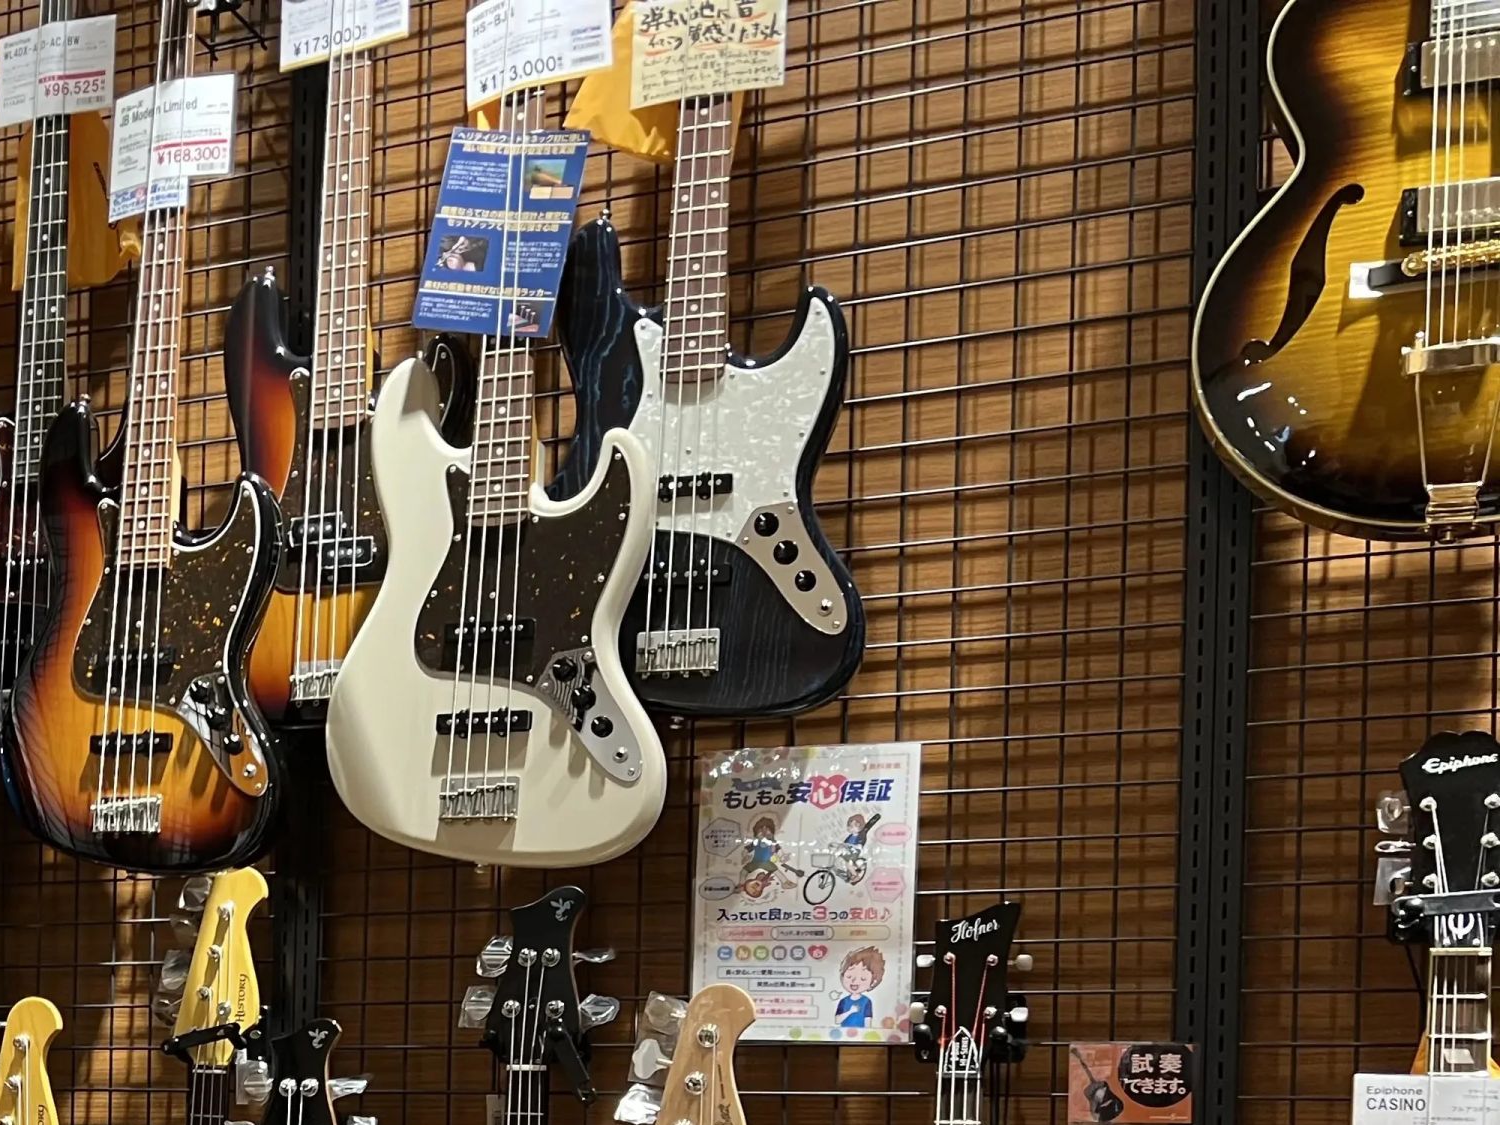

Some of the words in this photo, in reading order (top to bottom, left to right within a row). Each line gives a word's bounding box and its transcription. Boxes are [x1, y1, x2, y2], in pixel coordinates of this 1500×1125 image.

[293, 25, 362, 57] ¥173,000
[44, 79, 100, 98] ¥96,525
[119, 114, 131, 128] JB
[132, 106, 161, 124] Moden
[156, 146, 222, 165] ¥168,300
[1421, 753, 1499, 775] Epiphone
[722, 774, 895, 811] もしもの安心保証
[235, 973, 250, 1025] HISTORY
[1131, 1052, 1183, 1074] 試奏
[1366, 1085, 1424, 1096] Epiphone
[1366, 1097, 1427, 1112] CASINO
